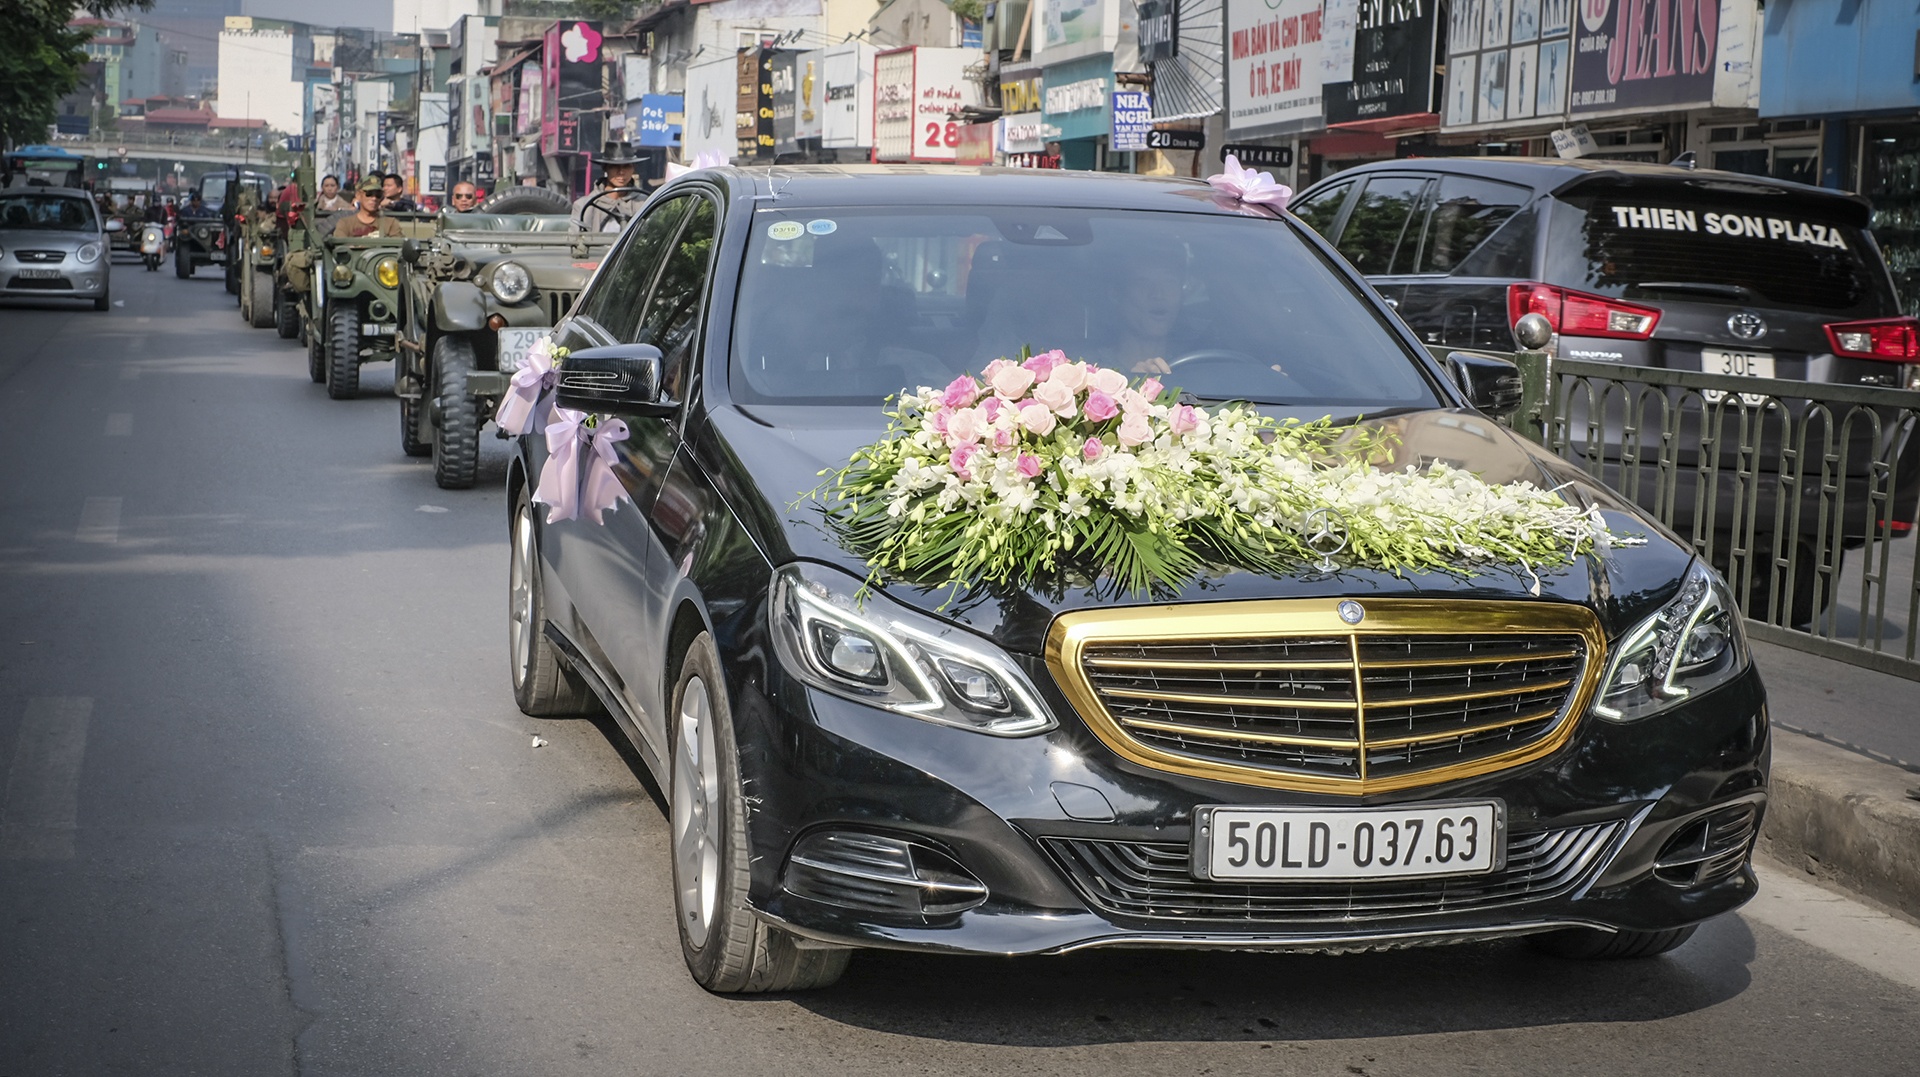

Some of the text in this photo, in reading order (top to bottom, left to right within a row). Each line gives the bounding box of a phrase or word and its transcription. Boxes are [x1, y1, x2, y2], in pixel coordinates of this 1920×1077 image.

[1233, 28, 1249, 60] MUA
[1251, 18, 1267, 57] BÁN
[1269, 14, 1280, 52] VÀ
[1282, 15, 1298, 49] CHO
[1301, 3, 1322, 44] THUÊ
[1250, 62, 1255, 98] Ô
[1270, 62, 1281, 94] XE
[1283, 52, 1302, 92] MÁY
[641, 118, 669, 133] Shop
[643, 107, 663, 119] Pet
[925, 122, 961, 149] 28
[1151, 131, 1170, 147] 20
[478, 161, 492, 172] 70
[1611, 206, 1848, 250] THIEN SON PLAZA
[1721, 352, 1757, 377] 30E
[1227, 816, 1479, 869] 50LD-037.63
